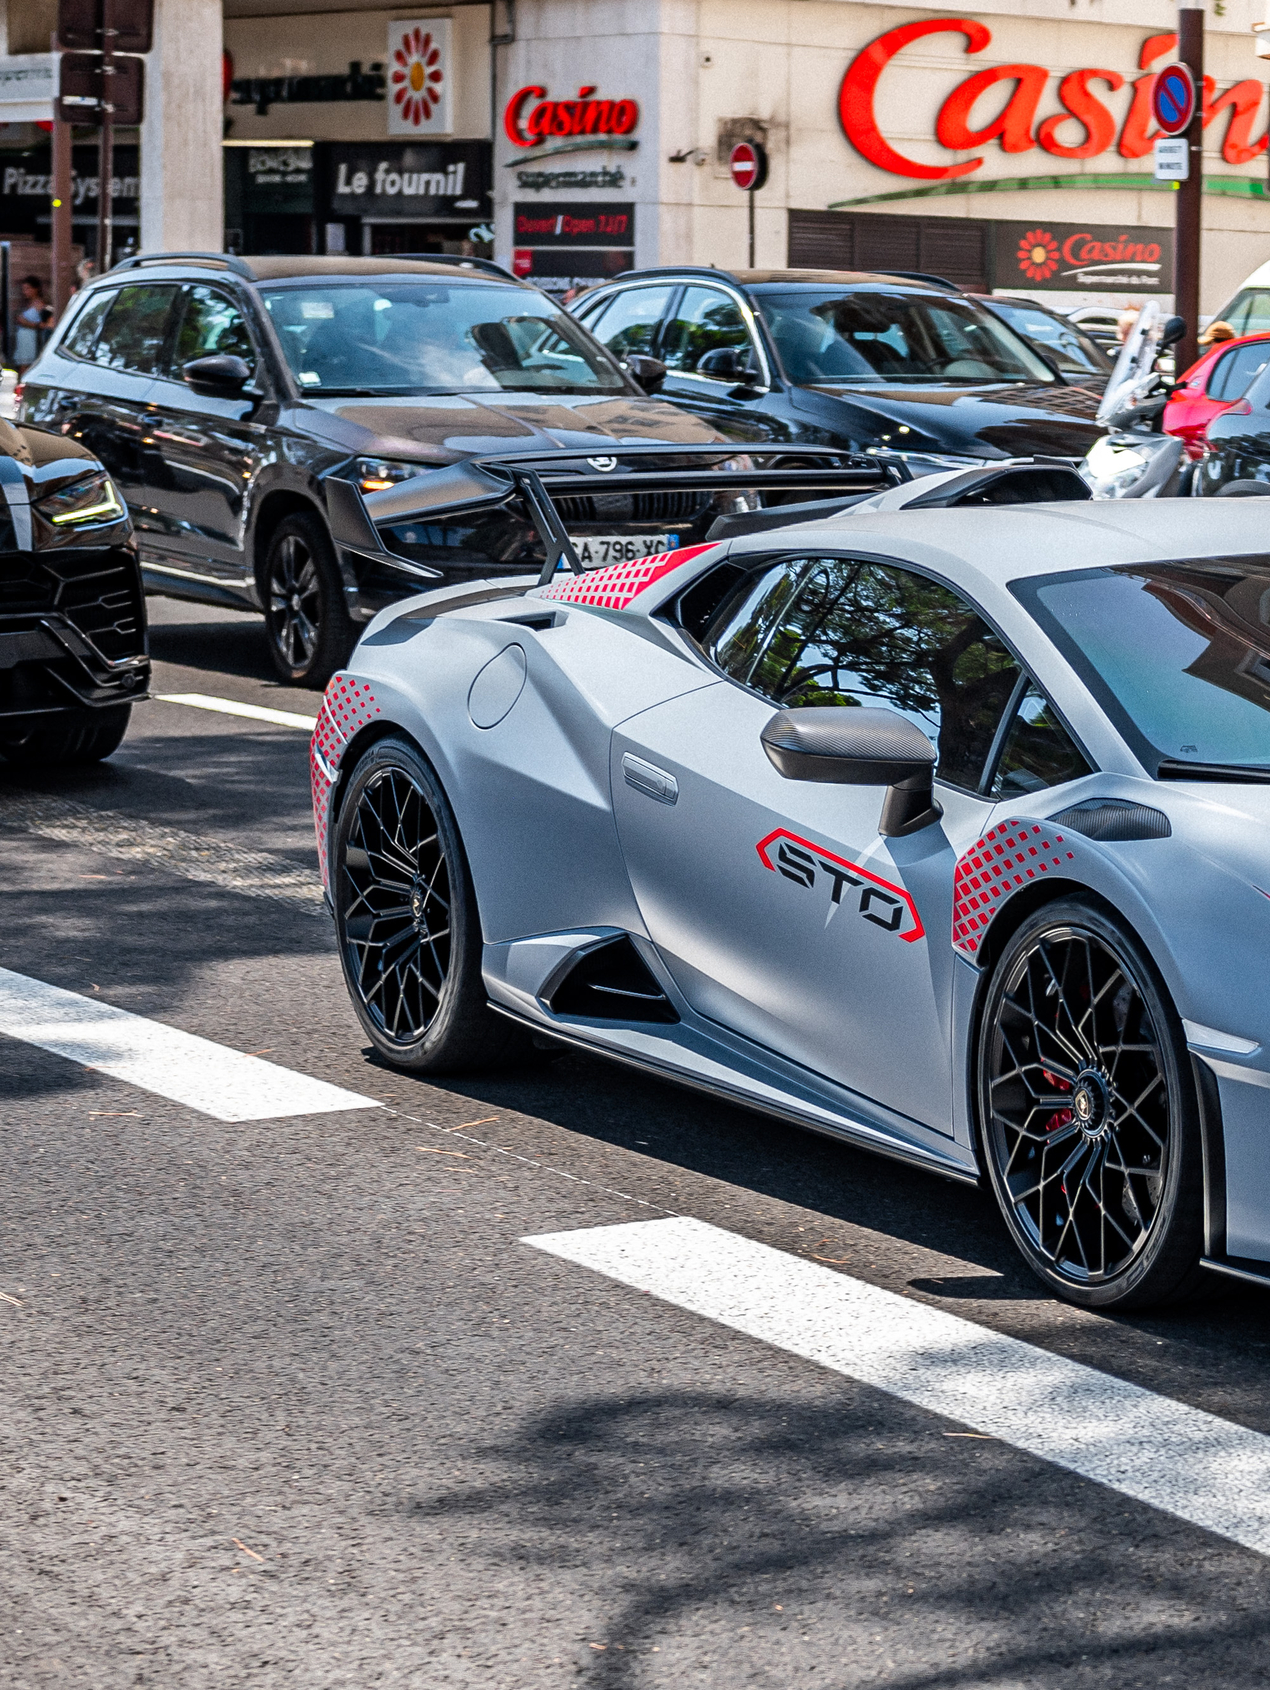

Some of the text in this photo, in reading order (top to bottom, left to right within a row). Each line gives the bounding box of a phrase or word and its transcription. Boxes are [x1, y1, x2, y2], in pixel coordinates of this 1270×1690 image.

[503, 84, 640, 148] Casino
[337, 161, 466, 196] Le fournil
[1061, 232, 1162, 267] Casino
[572, 539, 667, 563] A-796-XC
[777, 842, 903, 932] STO
